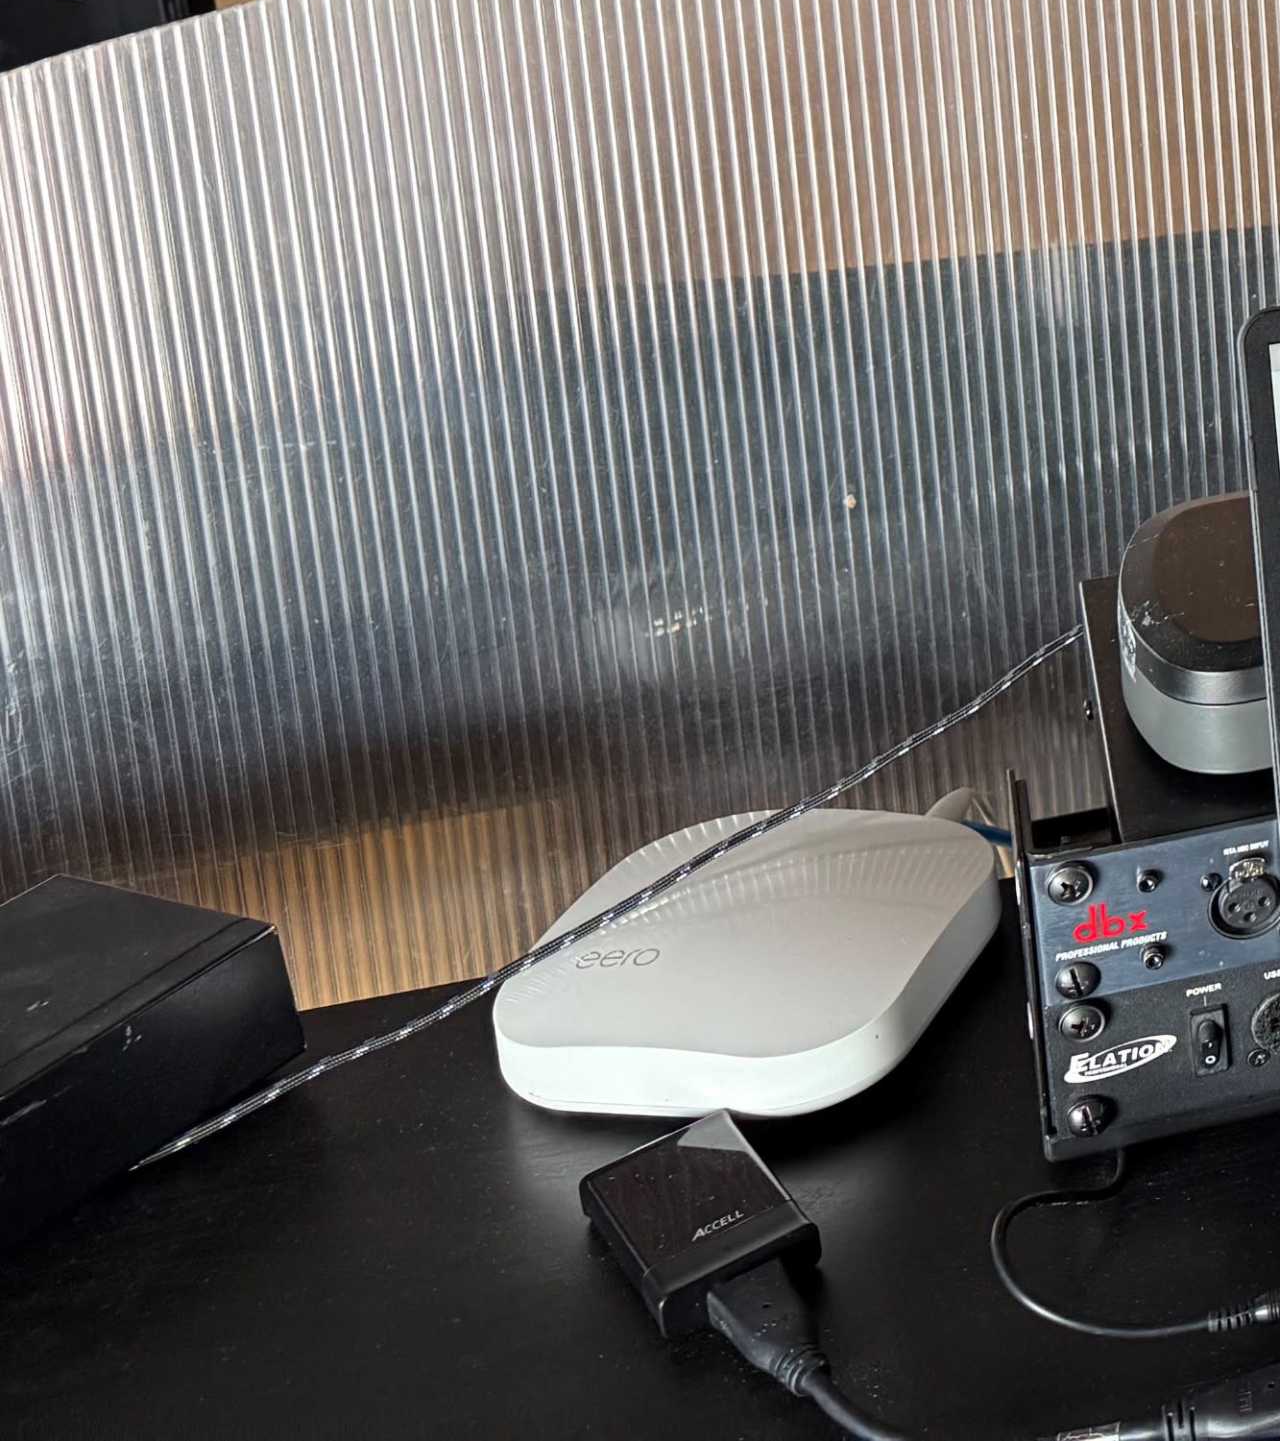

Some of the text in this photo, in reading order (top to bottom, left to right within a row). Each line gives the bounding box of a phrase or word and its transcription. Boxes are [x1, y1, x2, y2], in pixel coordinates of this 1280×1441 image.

[1072, 902, 1149, 944] dbx
[575, 947, 660, 970] eero
[1056, 931, 1167, 962] PROFESSIONAL PRODUCTS
[1186, 983, 1222, 998] POWER
[1070, 1039, 1170, 1075] ELATION
[692, 1209, 744, 1242] ACCELL
